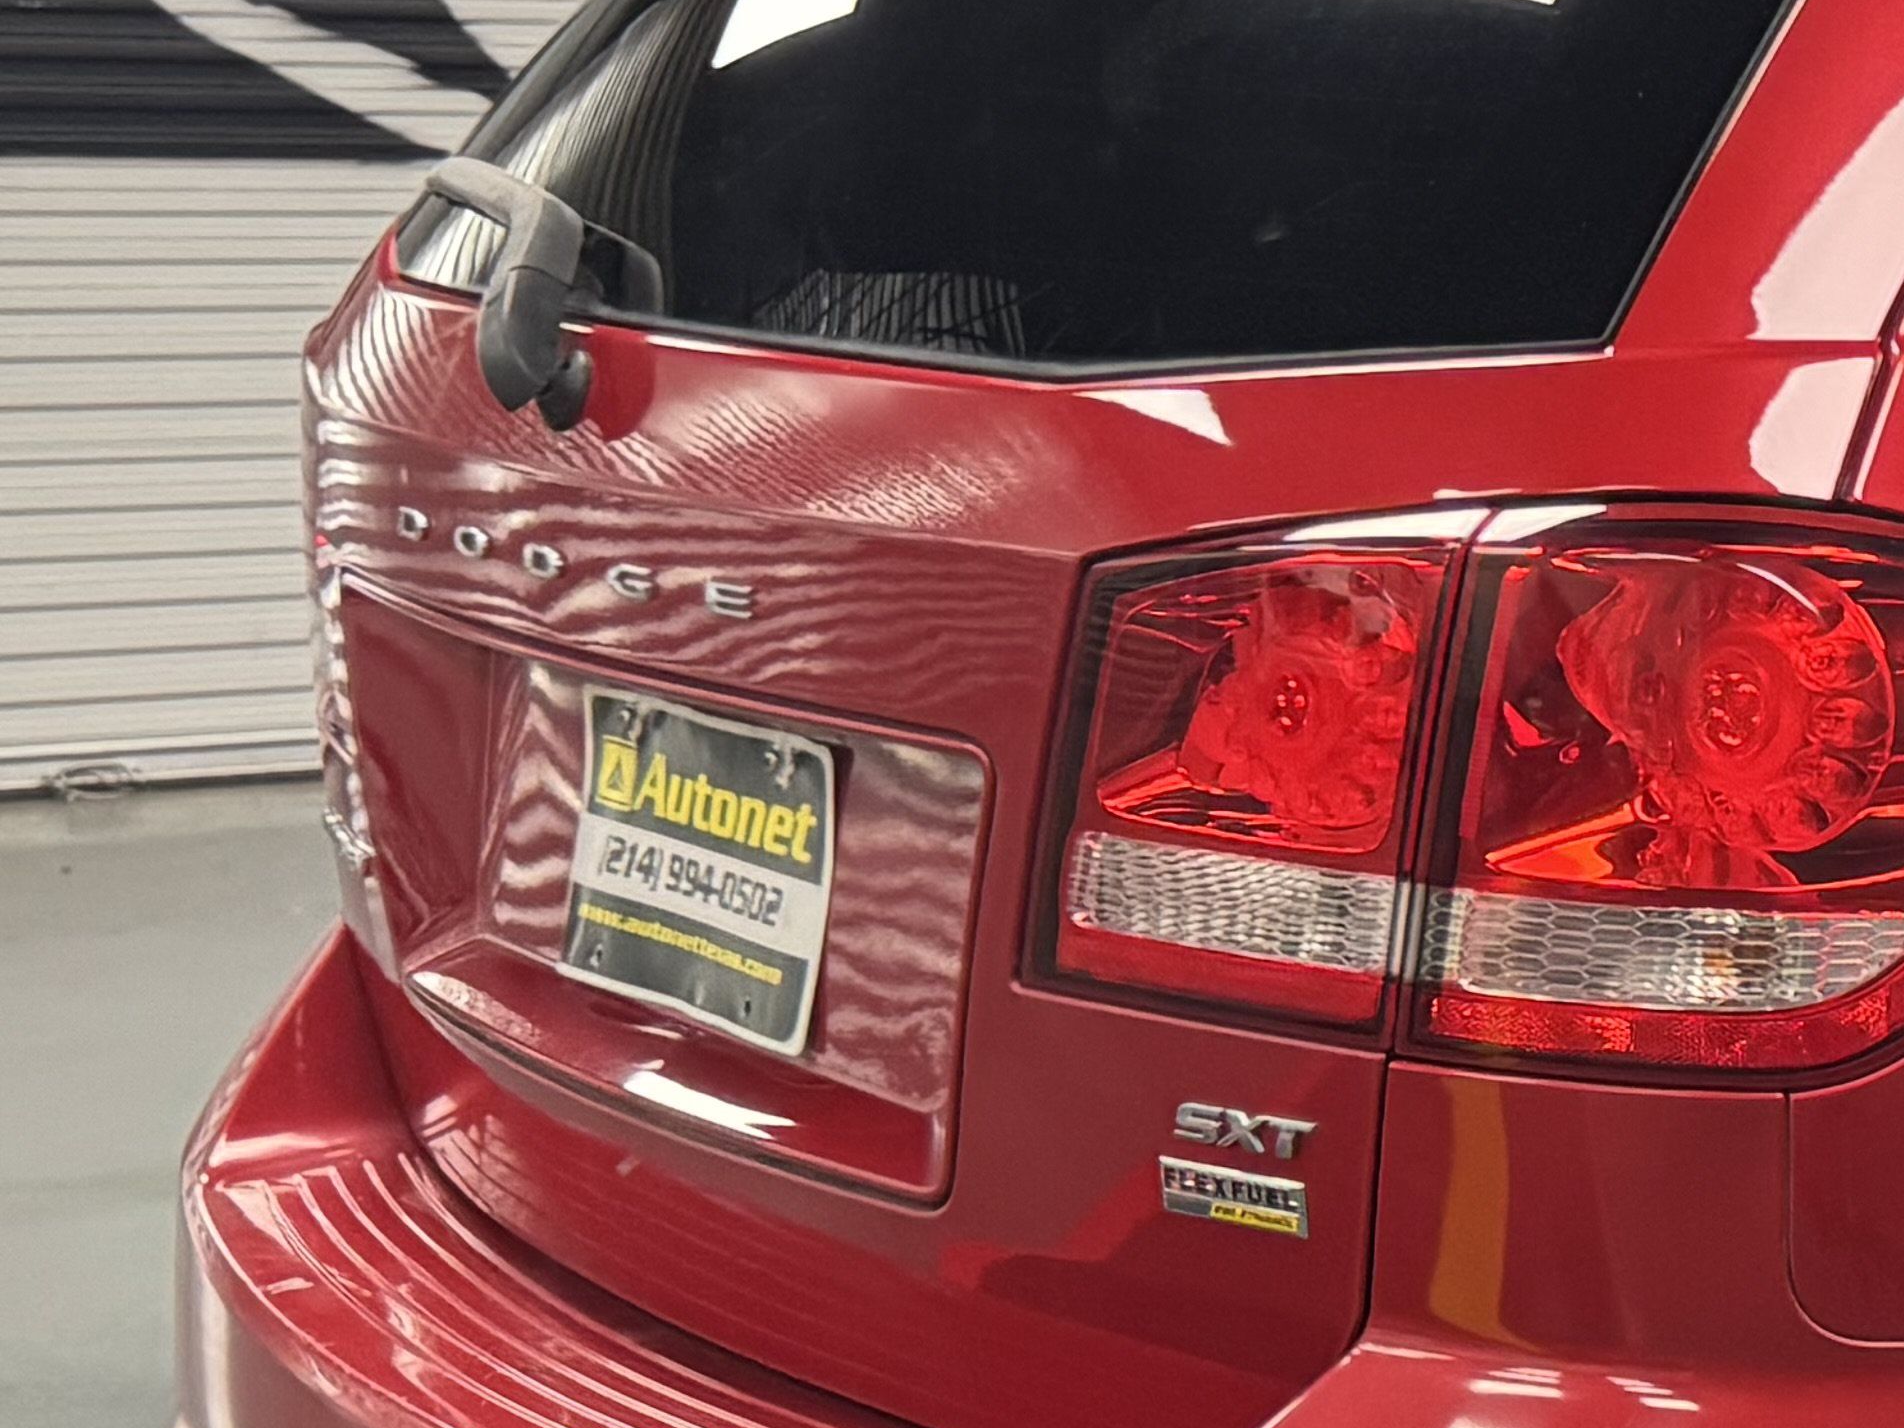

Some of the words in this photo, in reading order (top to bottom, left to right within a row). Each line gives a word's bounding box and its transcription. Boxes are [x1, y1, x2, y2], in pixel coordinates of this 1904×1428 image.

[398, 505, 756, 620] DODGE
[633, 753, 817, 864] Autonet
[598, 835, 664, 893] (214)
[665, 853, 784, 928] 994-0502
[1173, 1101, 1319, 1160] SXT
[1163, 1166, 1300, 1209] FLEXFUEL
